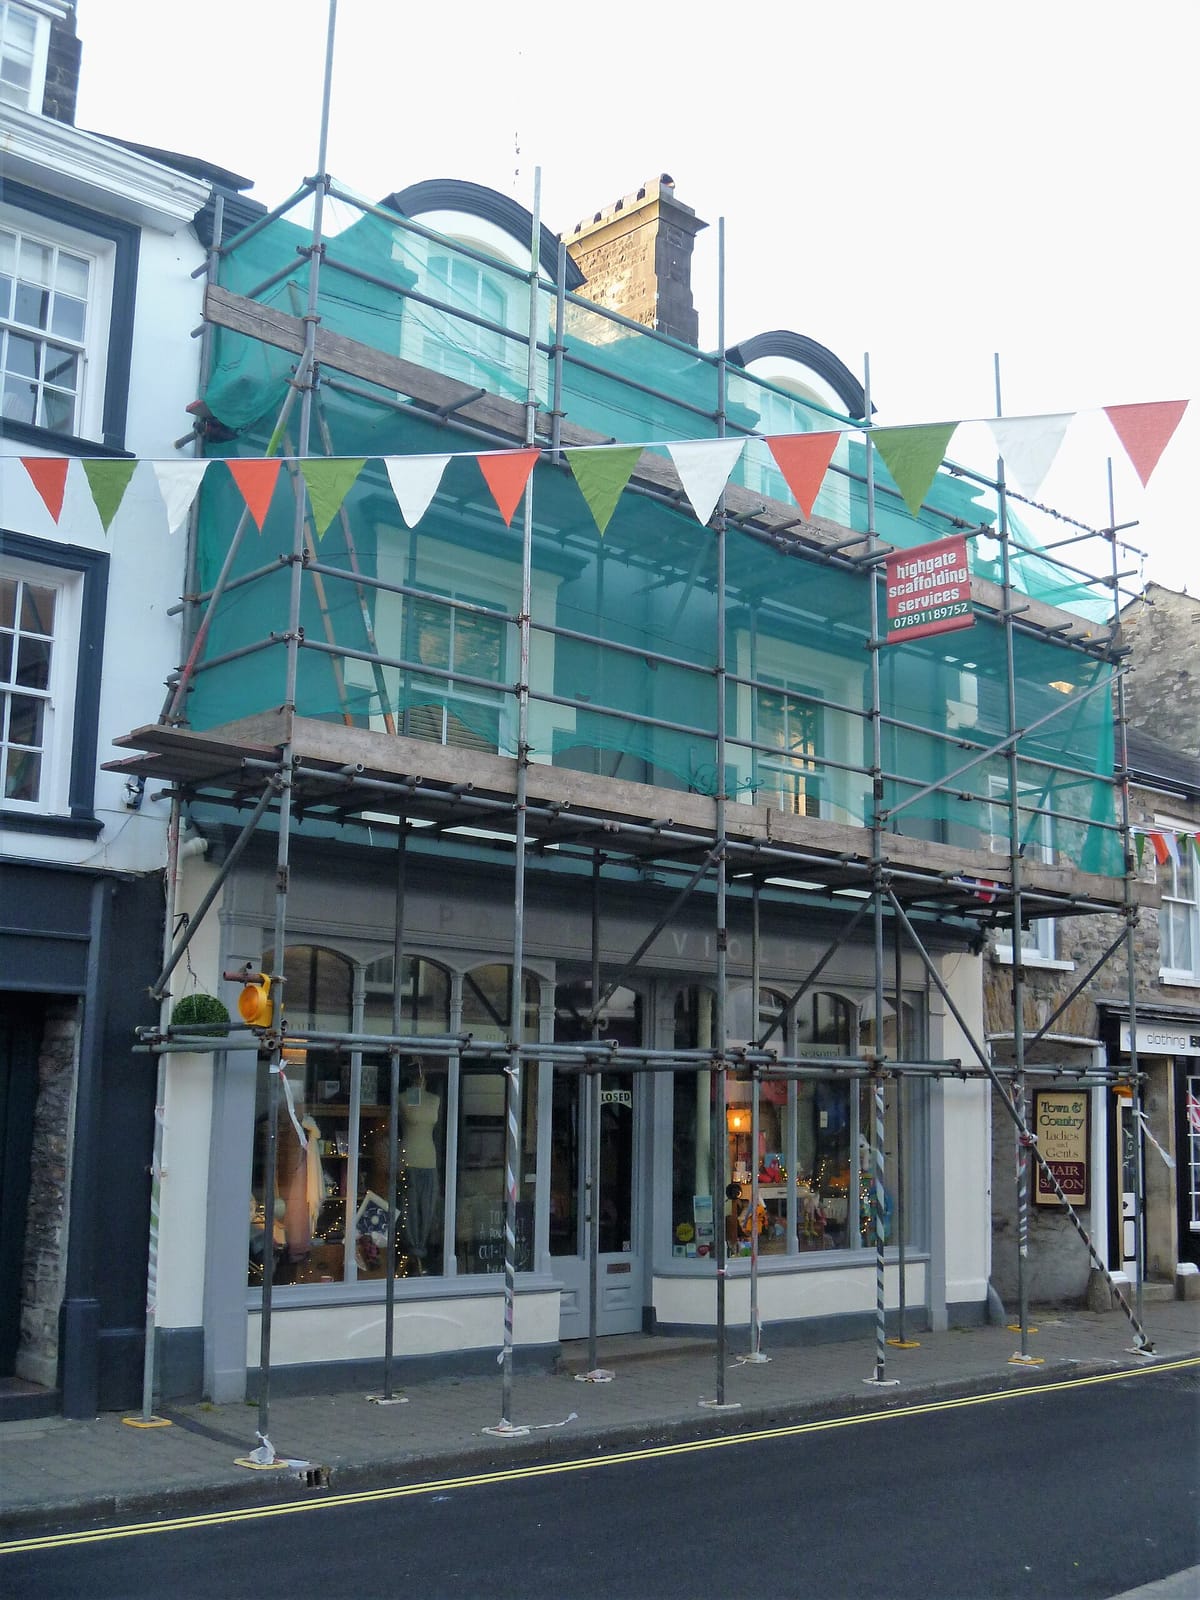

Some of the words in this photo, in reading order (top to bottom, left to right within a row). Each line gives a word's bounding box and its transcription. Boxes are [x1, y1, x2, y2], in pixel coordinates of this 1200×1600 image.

[896, 552, 957, 579] highgate
[889, 567, 967, 598] scaffolding
[898, 588, 960, 613] services
[894, 602, 968, 628] 07891189752
[601, 1092, 630, 1102] LOSED
[1041, 1102, 1069, 1113] Town
[1072, 1102, 1083, 1113] &
[1040, 1114, 1084, 1130] Country
[1046, 1130, 1079, 1141] Ladies
[1045, 1148, 1079, 1158] Gents
